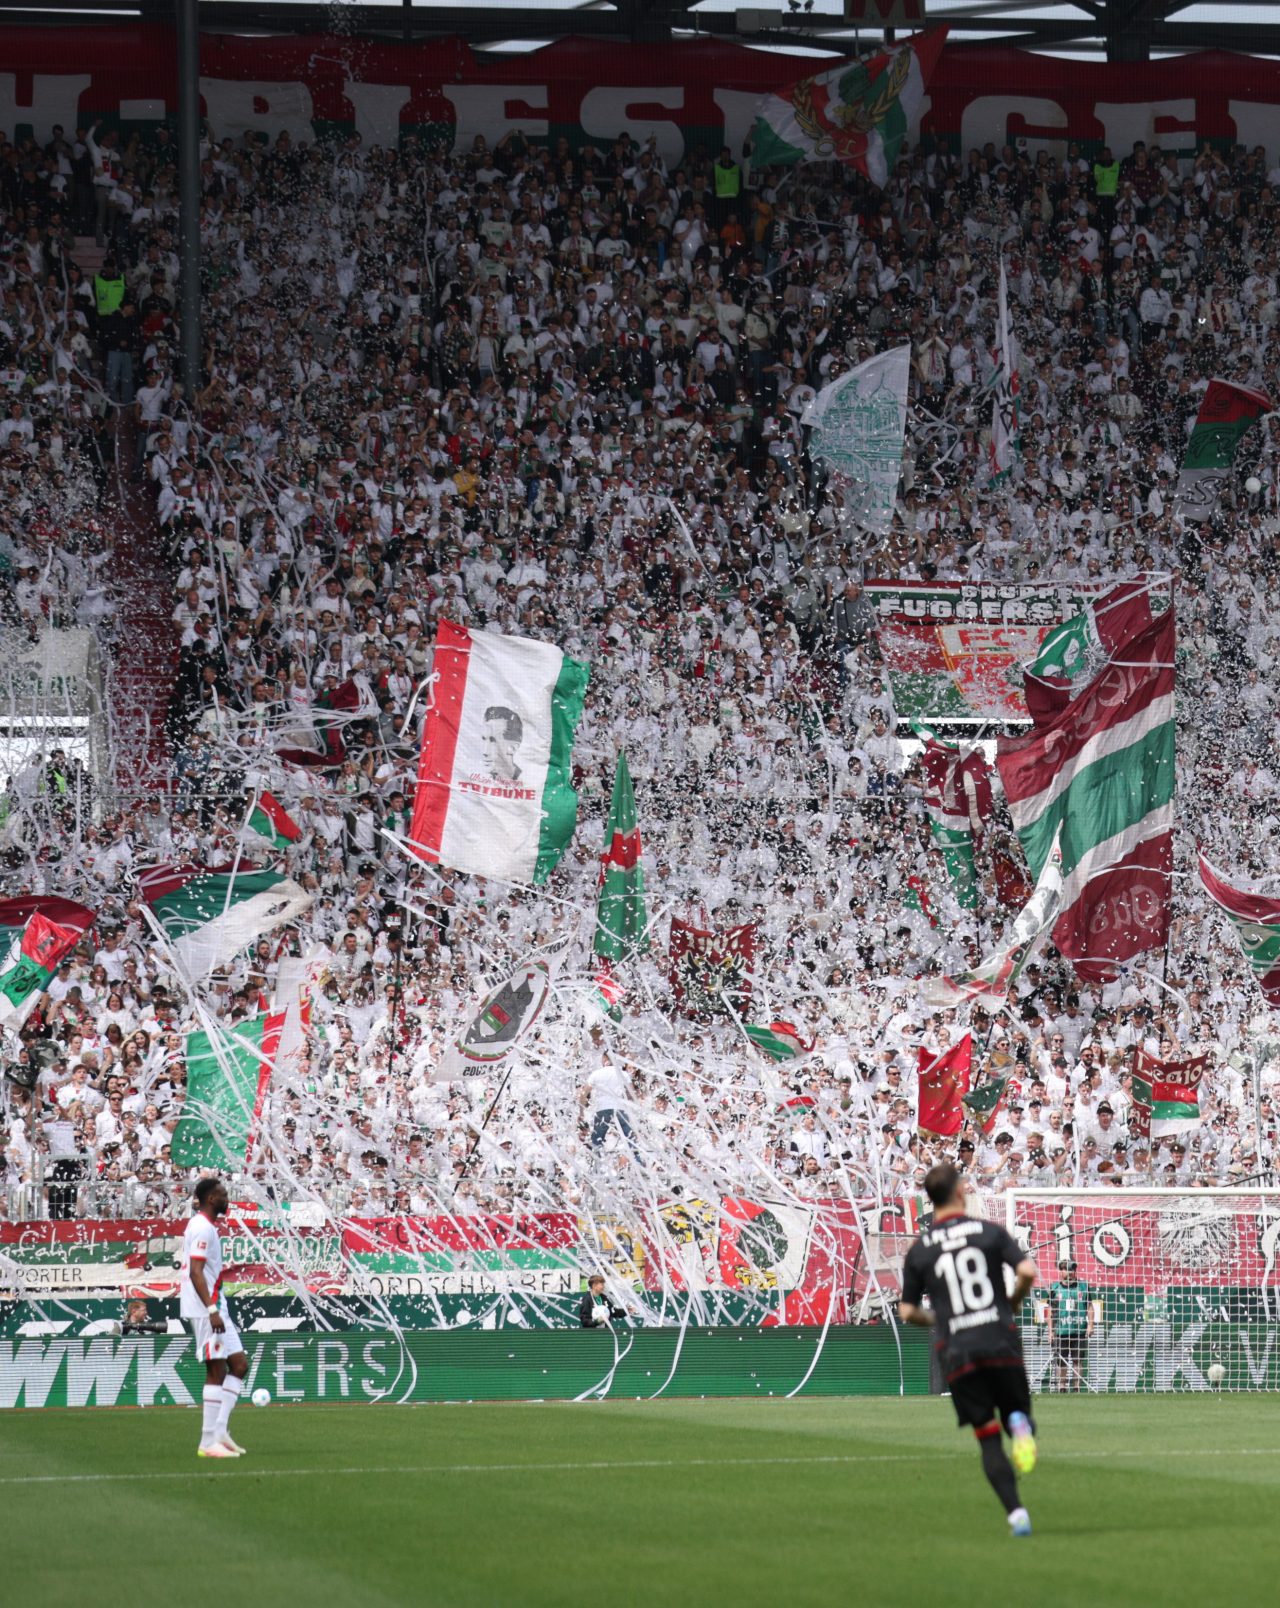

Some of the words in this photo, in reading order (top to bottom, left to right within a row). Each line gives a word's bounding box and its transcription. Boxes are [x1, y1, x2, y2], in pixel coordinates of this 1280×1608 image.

[353, 1273, 573, 1297] NORDSCHWBEN
[934, 1246, 995, 1316] 18
[0, 1337, 197, 1408] WWK
